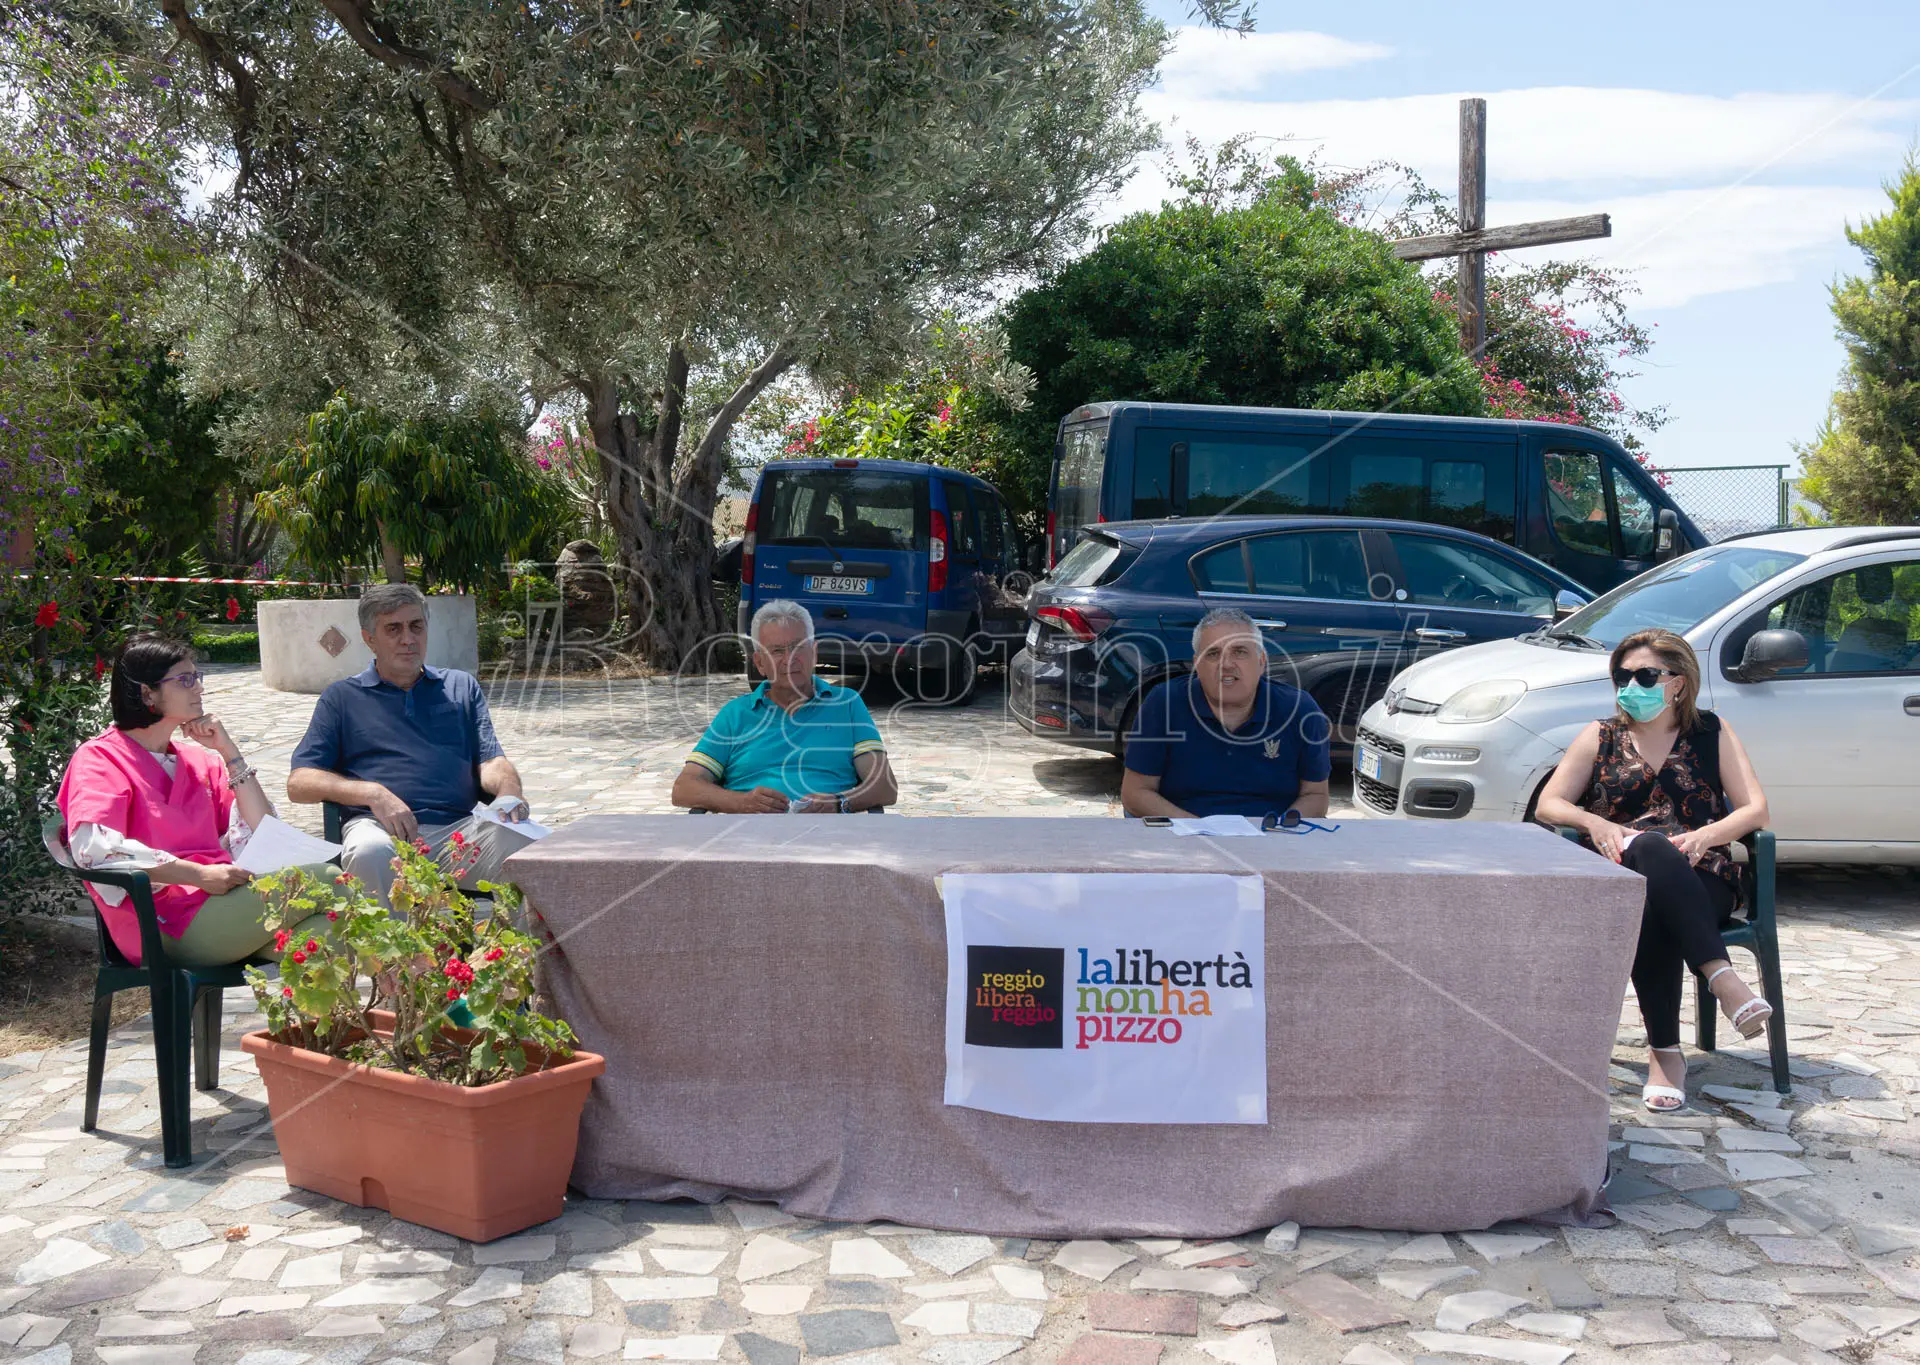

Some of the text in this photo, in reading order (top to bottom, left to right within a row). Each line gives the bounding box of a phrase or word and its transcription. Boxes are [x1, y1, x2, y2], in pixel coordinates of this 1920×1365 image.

[812, 577, 867, 591] DF 849VS
[981, 969, 1046, 992] reggio
[975, 986, 1037, 1008] libera
[991, 1001, 1057, 1028] reggio
[1075, 1005, 1183, 1050] pizzo
